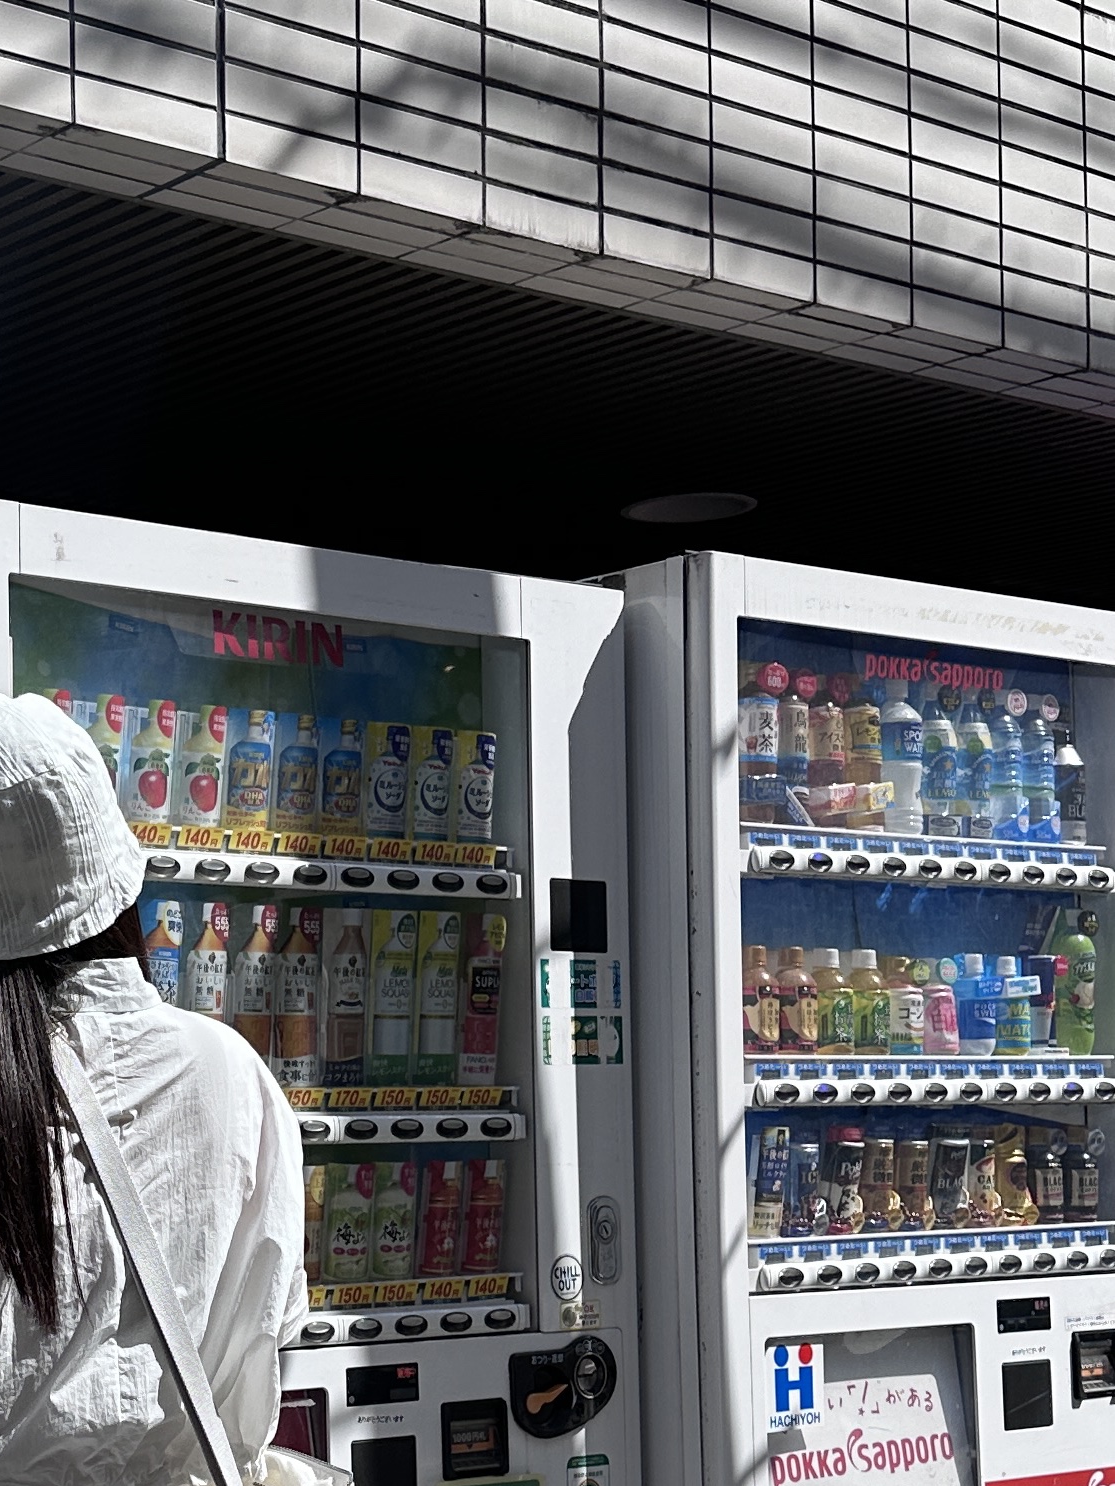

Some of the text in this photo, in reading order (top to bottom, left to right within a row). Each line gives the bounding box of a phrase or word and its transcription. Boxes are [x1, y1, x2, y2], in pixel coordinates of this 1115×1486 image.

[212, 609, 345, 667] KIRIN
[759, 712, 775, 753] 麦茶
[185, 829, 218, 846] 140円
[237, 832, 269, 850] 140円
[284, 835, 316, 855] 140円
[331, 838, 362, 856] 140円
[377, 842, 406, 859] 140円
[421, 844, 451, 861] 140円
[462, 846, 491, 863] 140円
[287, 1089, 319, 1106] 150円
[336, 1089, 365, 1106] 170円
[381, 1089, 411, 1105] 150円
[425, 1089, 456, 1105] 150円
[468, 1088, 498, 1105] 150円
[554, 1266, 580, 1279] CHILL
[382, 1284, 413, 1301] 150円
[430, 1281, 460, 1298] 140円
[474, 1277, 504, 1294] 140円
[558, 1278, 577, 1291] OUT
[338, 1286, 369, 1303] 150円
[357, 1415, 404, 1424] ありがとうございます
[769, 1410, 821, 1429] HACHIYOH
